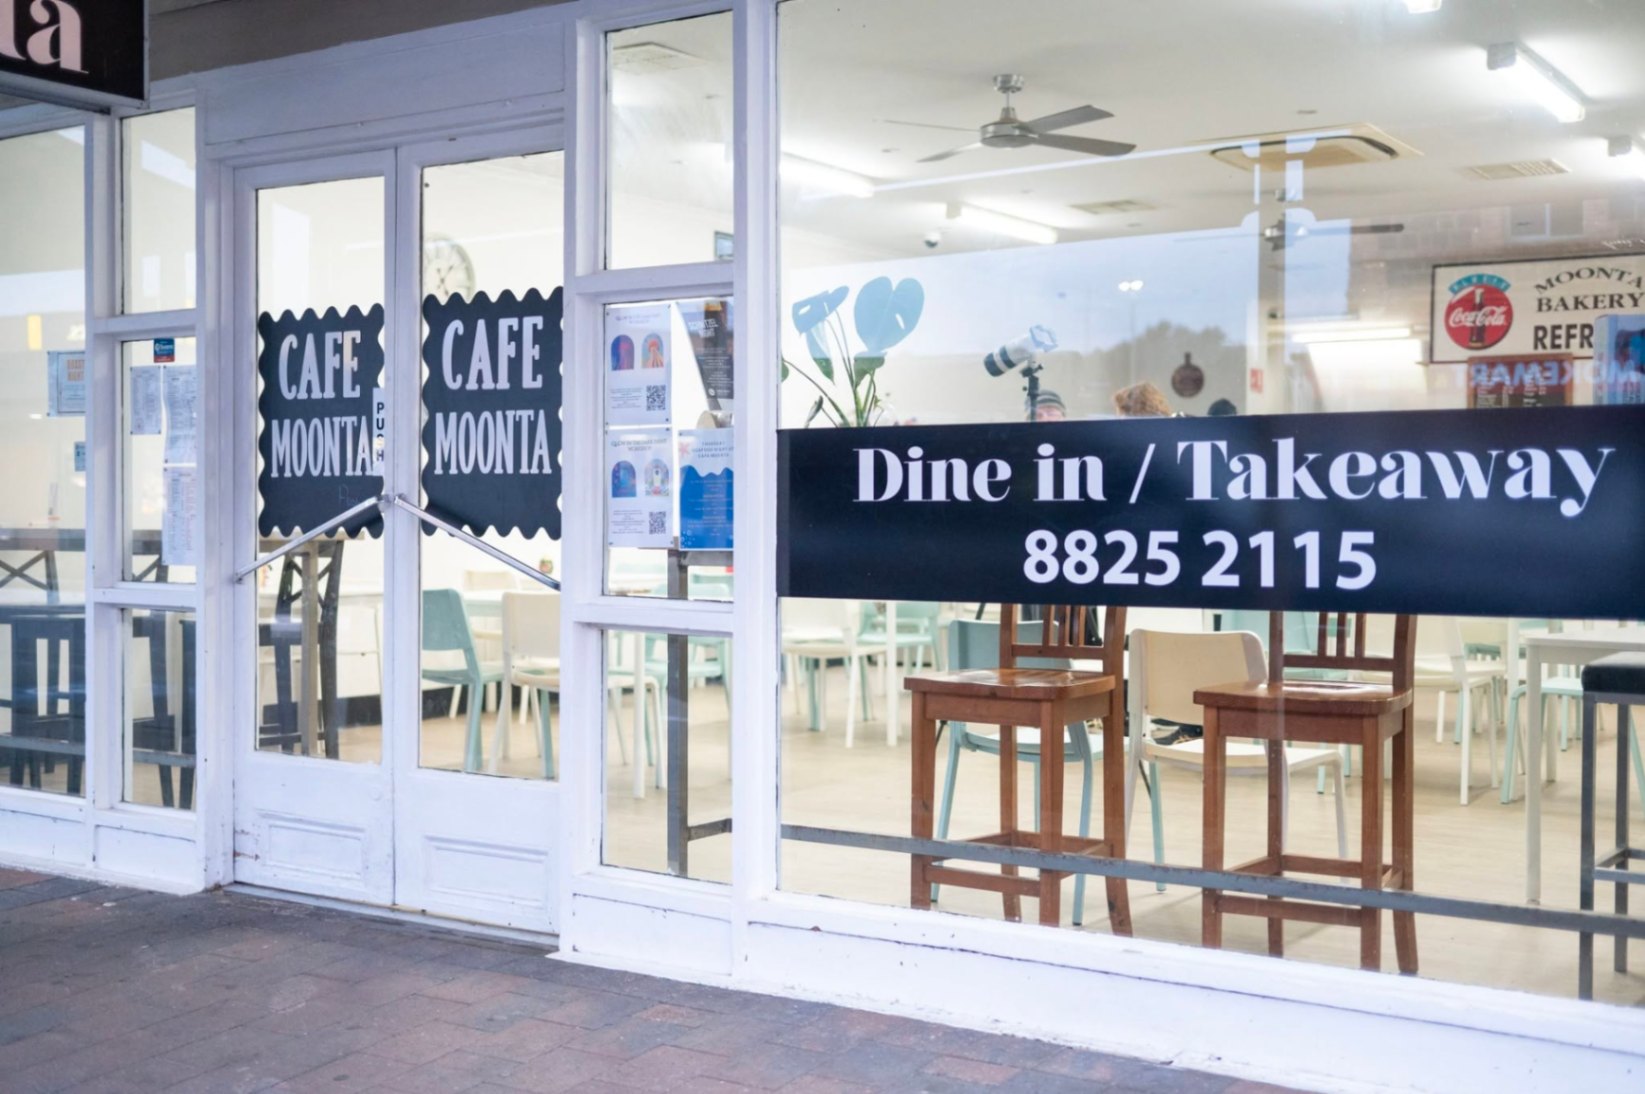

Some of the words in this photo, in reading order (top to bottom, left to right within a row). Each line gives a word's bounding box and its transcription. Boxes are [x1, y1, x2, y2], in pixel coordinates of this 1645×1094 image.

[1534, 267, 1643, 294] MOONTA
[1536, 292, 1645, 312] BAKERY
[278, 330, 361, 400] CAFE
[441, 315, 544, 390] CAFE
[271, 415, 374, 478] MOONTA
[434, 409, 552, 474] MOONTA
[852, 445, 1012, 502] Dine
[1032, 442, 1107, 501] in
[1128, 443, 1156, 504] /
[1177, 437, 1616, 517] Takeaway
[1023, 529, 1181, 586] 8825
[1200, 530, 1377, 590] 2115
